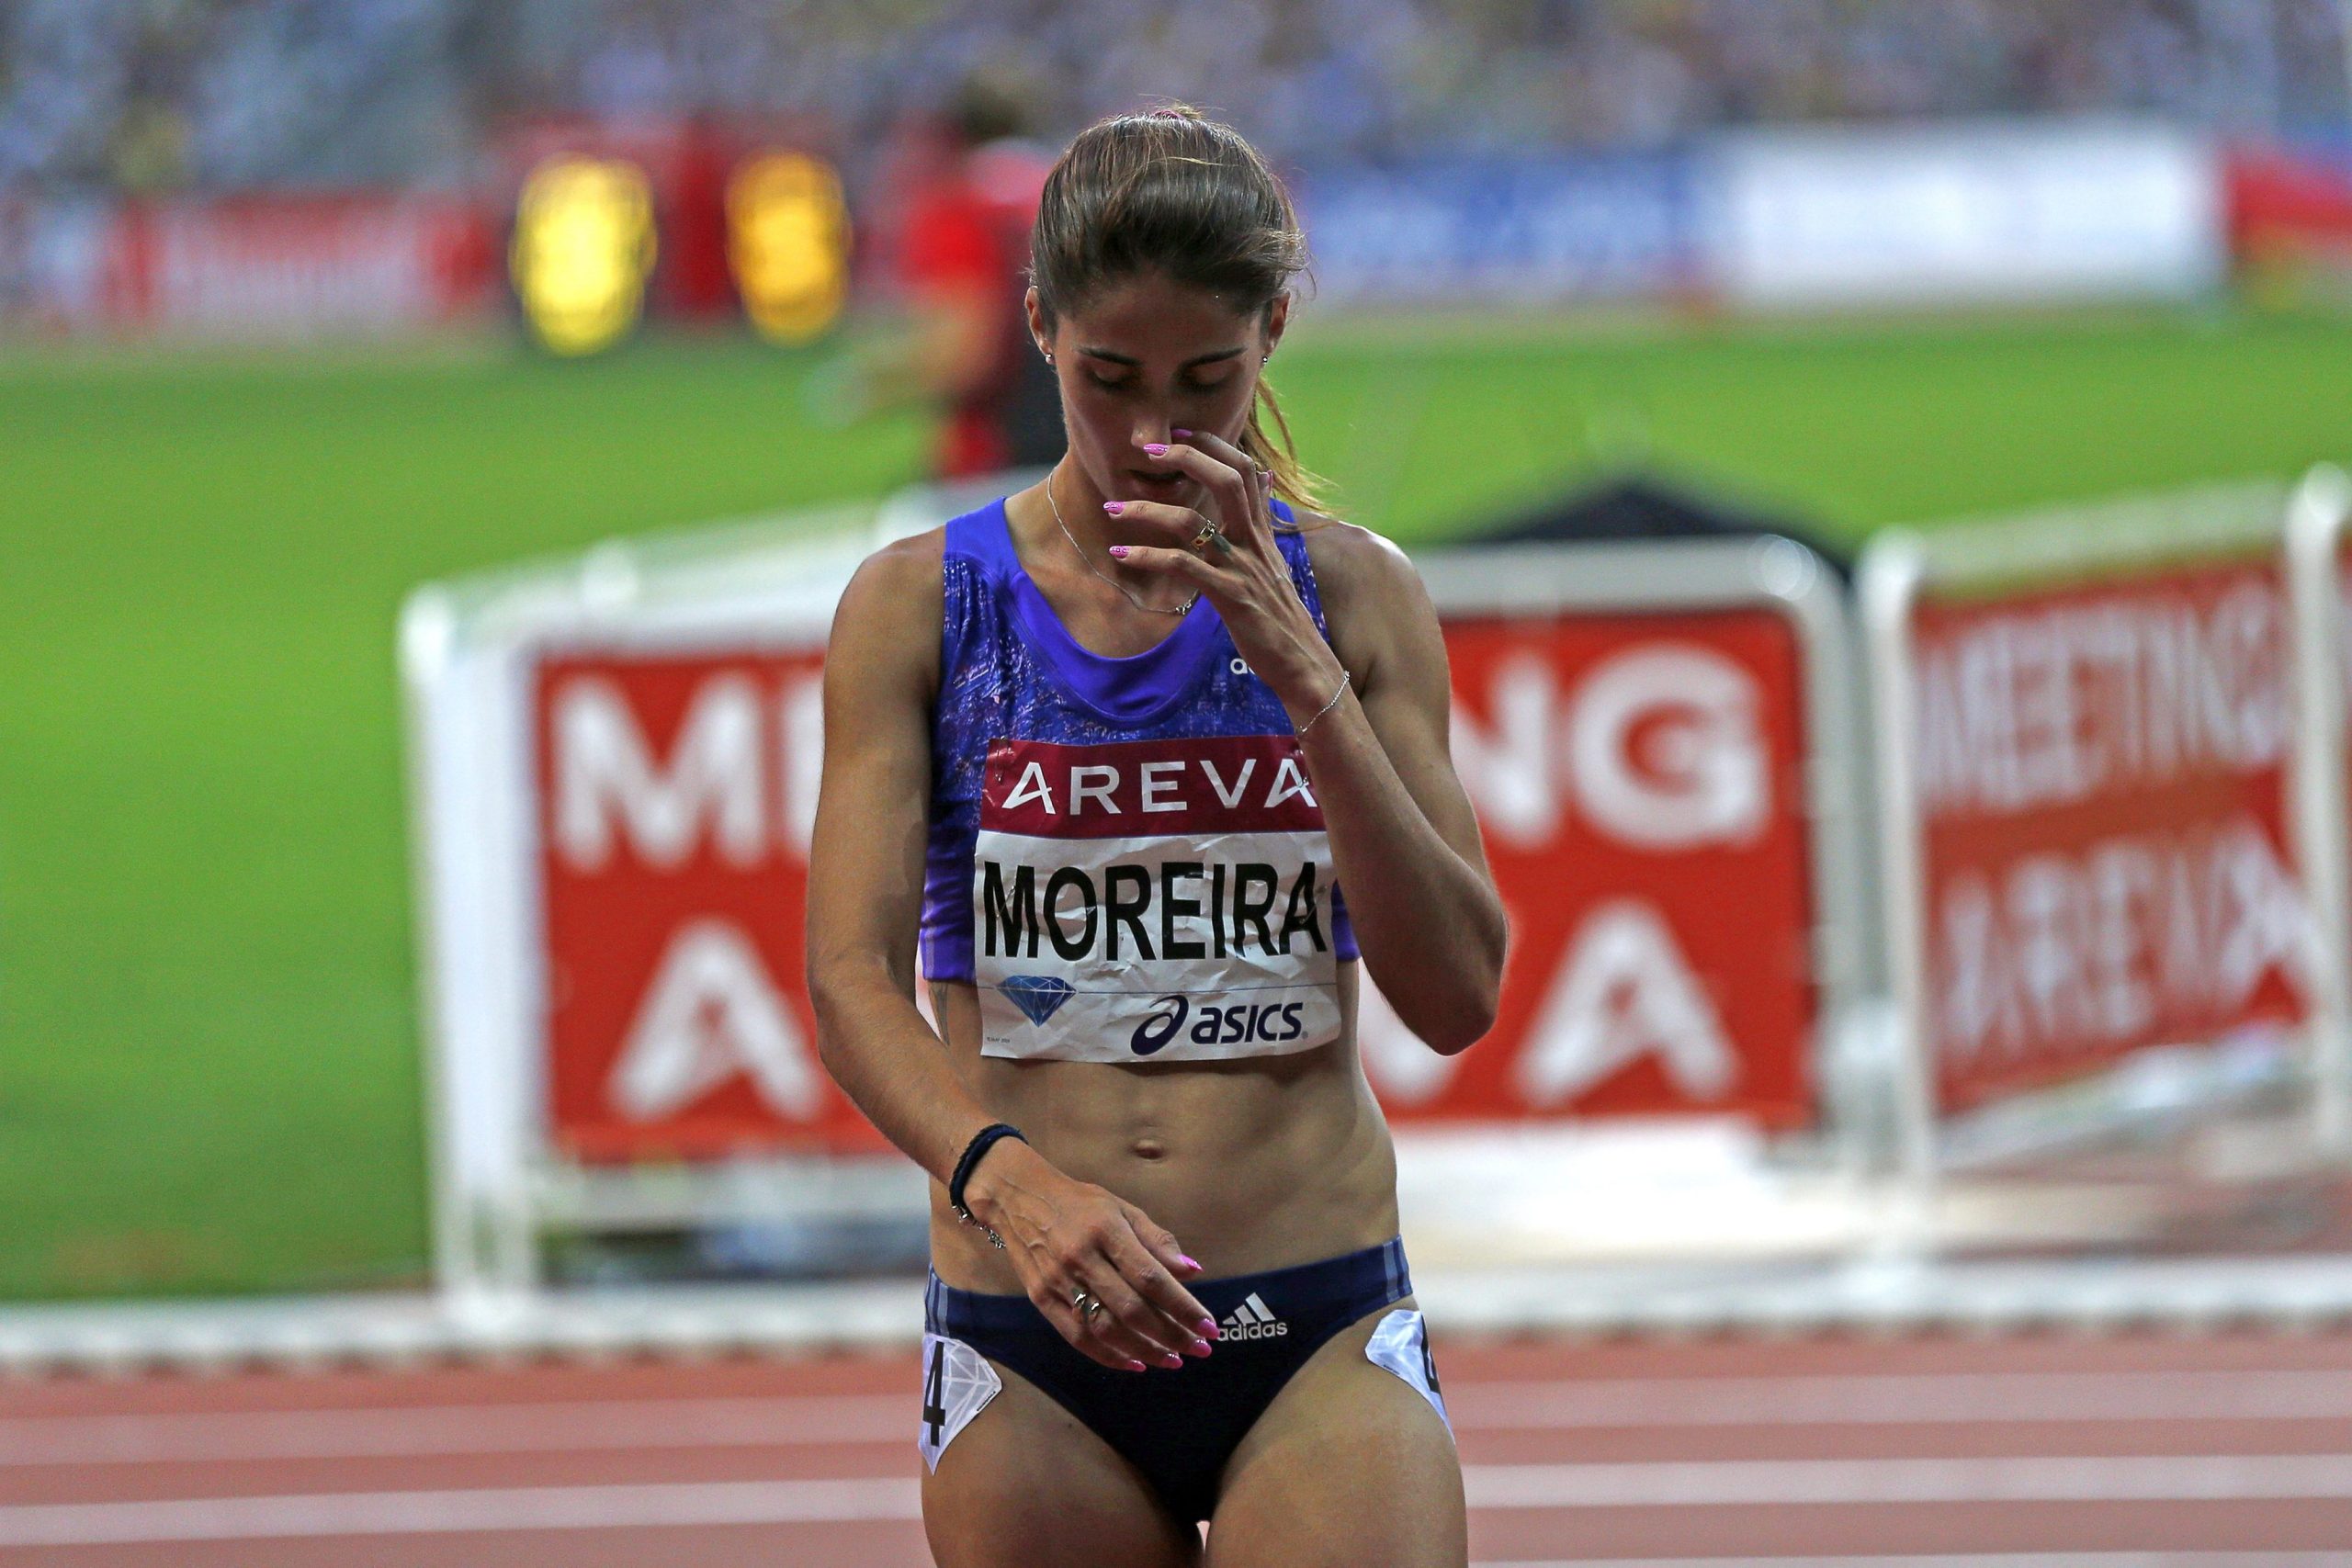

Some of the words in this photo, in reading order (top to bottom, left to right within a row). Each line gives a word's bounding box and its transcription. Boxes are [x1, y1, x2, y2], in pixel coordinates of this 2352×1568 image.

[1001, 758, 1317, 815] AREVA
[983, 861, 1327, 962] MOREIRA
[1191, 1002, 1304, 1044] asics
[1217, 1321, 1288, 1341] adidas
[922, 1340, 946, 1448] 4
